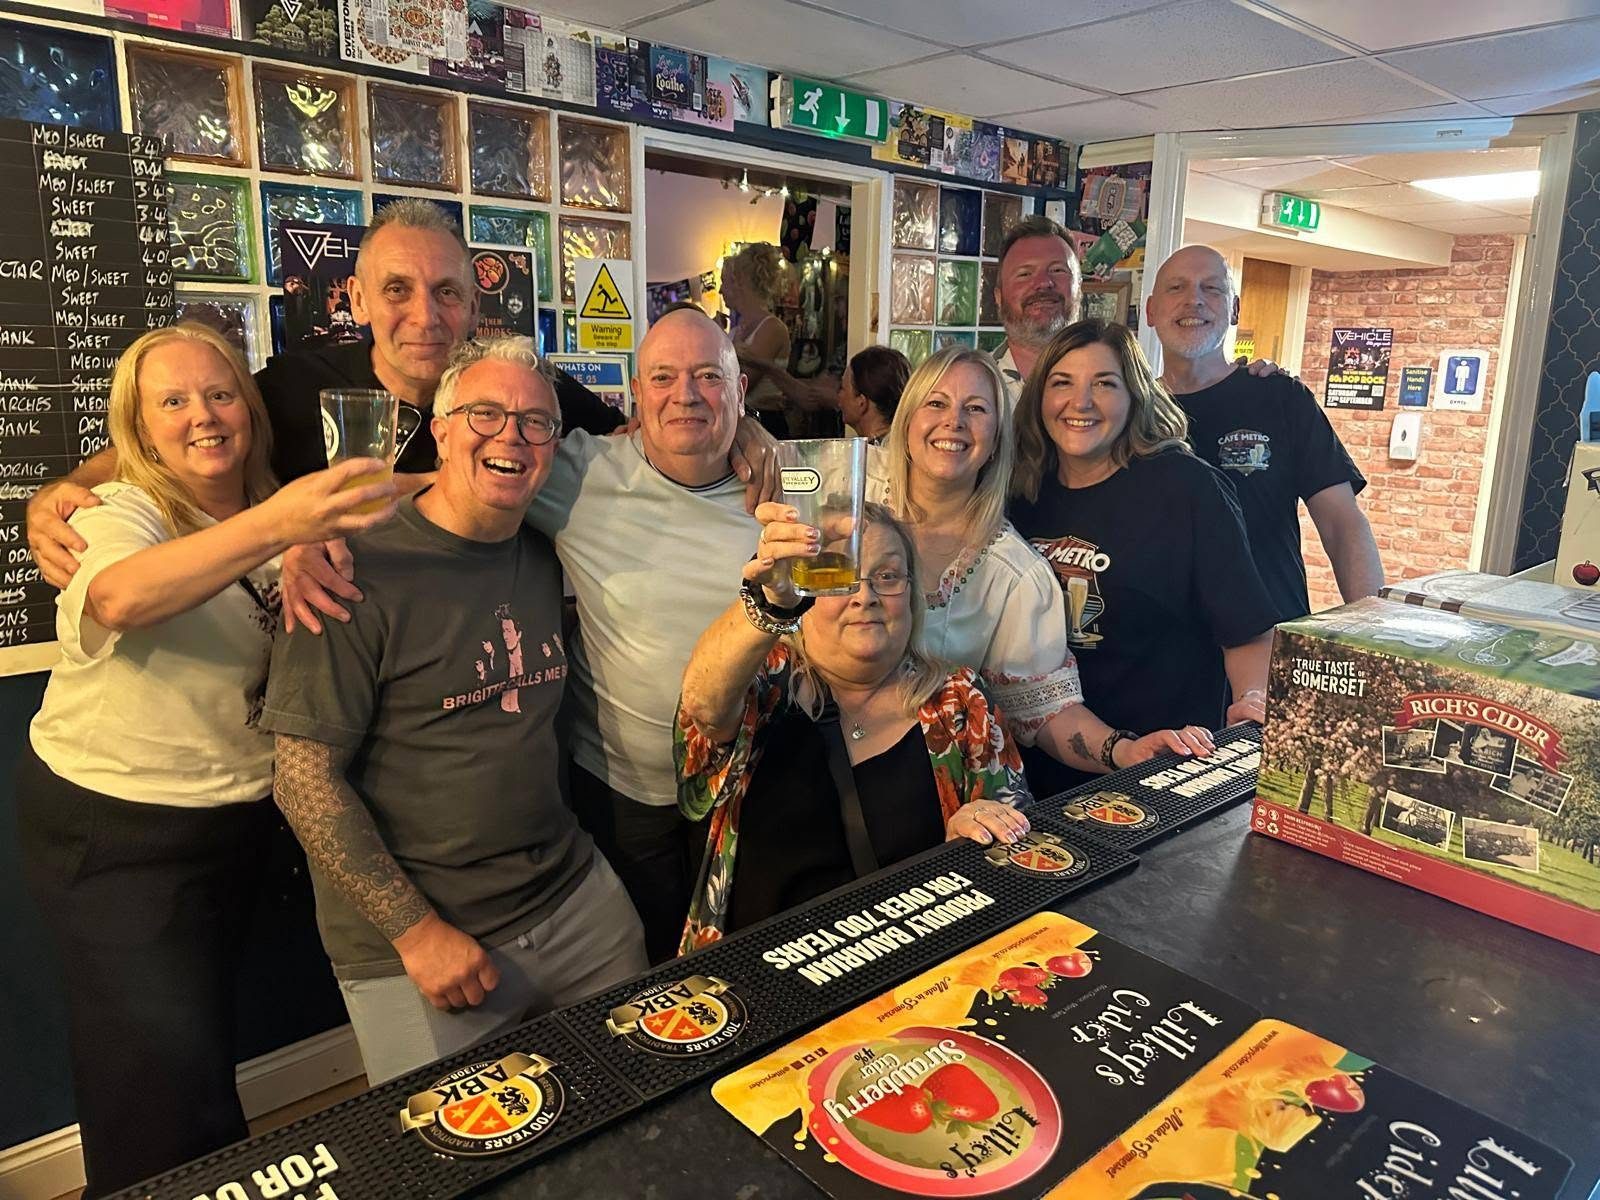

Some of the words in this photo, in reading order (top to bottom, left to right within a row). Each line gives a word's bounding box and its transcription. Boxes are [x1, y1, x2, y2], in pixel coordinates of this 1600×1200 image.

[656, 74, 684, 92] Loathe
[52, 196, 95, 216] SWEET
[55, 242, 98, 260] SWEET
[0, 259, 43, 280] CTAR
[61, 287, 99, 305] SWEET
[0, 327, 35, 345] ANK
[67, 331, 111, 350] SWEET
[591, 325, 622, 335] Warning
[1335, 331, 1391, 345] VEHICLE
[556, 363, 586, 371] WHATS
[1343, 375, 1360, 383] POP
[1361, 376, 1386, 384] ROCK
[1241, 433, 1270, 442] METRO
[1048, 547, 1110, 572] METRO
[1296, 658, 1321, 671] TRUE
[1324, 660, 1356, 677] TASTE
[443, 681, 507, 709] BRIGITTE
[545, 666, 560, 682] ME
[1292, 669, 1367, 697] SOMERSET
[1409, 698, 1479, 718] RICH'S
[1481, 706, 1550, 749] CIDER
[924, 872, 973, 896] FOR
[874, 887, 936, 919] OVER
[904, 889, 995, 938] PROUDLY
[834, 910, 888, 938] 700
[762, 929, 846, 970] YEARS
[798, 926, 915, 986] BAVARIAN
[923, 976, 951, 994] Made
[631, 984, 694, 1016] ABK
[877, 995, 921, 1023] Somerset
[1069, 989, 1150, 1044] Cider
[722, 1022, 741, 1038] 700
[687, 1037, 723, 1053] YEARS
[854, 1048, 875, 1064] 4%
[1095, 1001, 1223, 1087] Lilley's
[859, 1053, 899, 1080] Cider
[434, 1064, 508, 1106] ABK
[822, 1039, 966, 1124] Strawberry
[530, 1111, 554, 1131] 700
[1160, 1107, 1183, 1137] Made
[430, 1126, 475, 1149] TRADITION
[484, 1130, 532, 1150] YEARS
[940, 1105, 1041, 1179] Lilley's
[252, 1143, 339, 1199] FOR
[1106, 1139, 1149, 1179] Somerset
